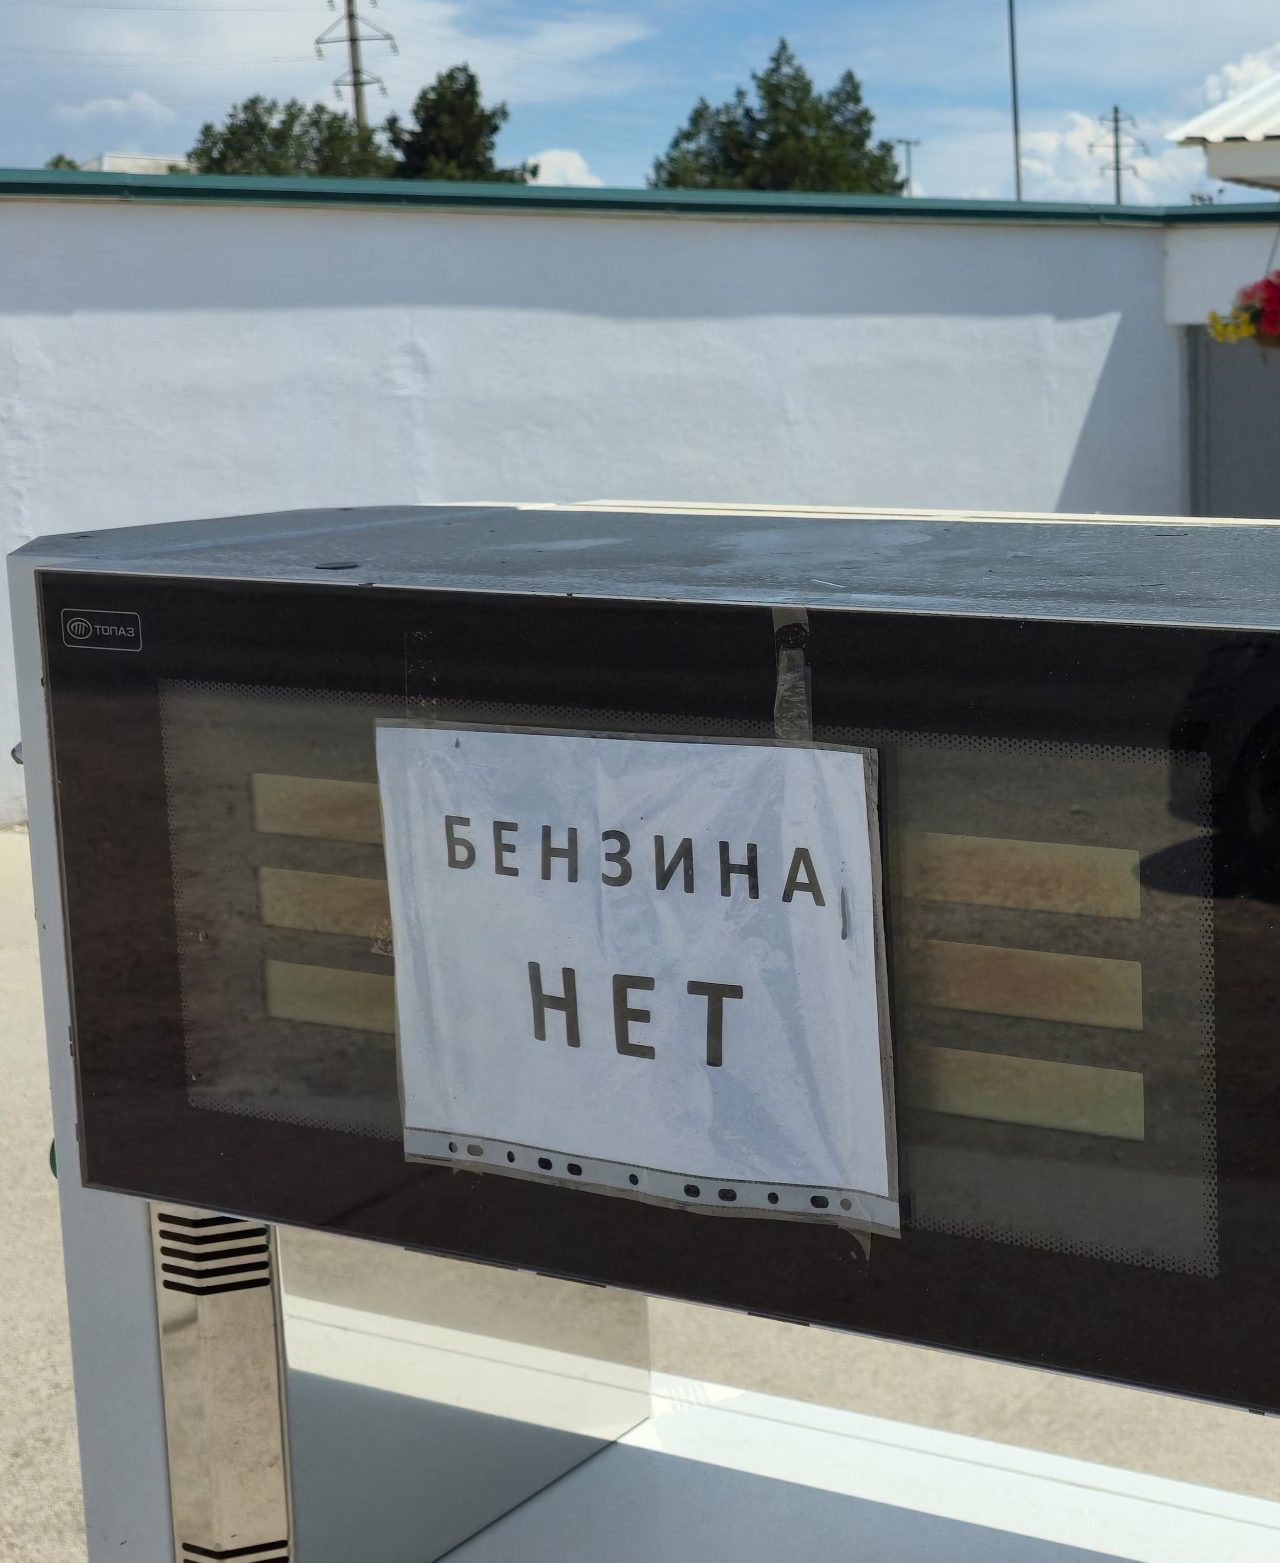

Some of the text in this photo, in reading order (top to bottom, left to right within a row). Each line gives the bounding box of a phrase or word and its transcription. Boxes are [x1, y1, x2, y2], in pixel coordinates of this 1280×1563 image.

[94, 625, 135, 637] ТОПАЗ
[444, 814, 826, 907] БЕНЗИНА
[528, 961, 744, 1067] НЕТ
